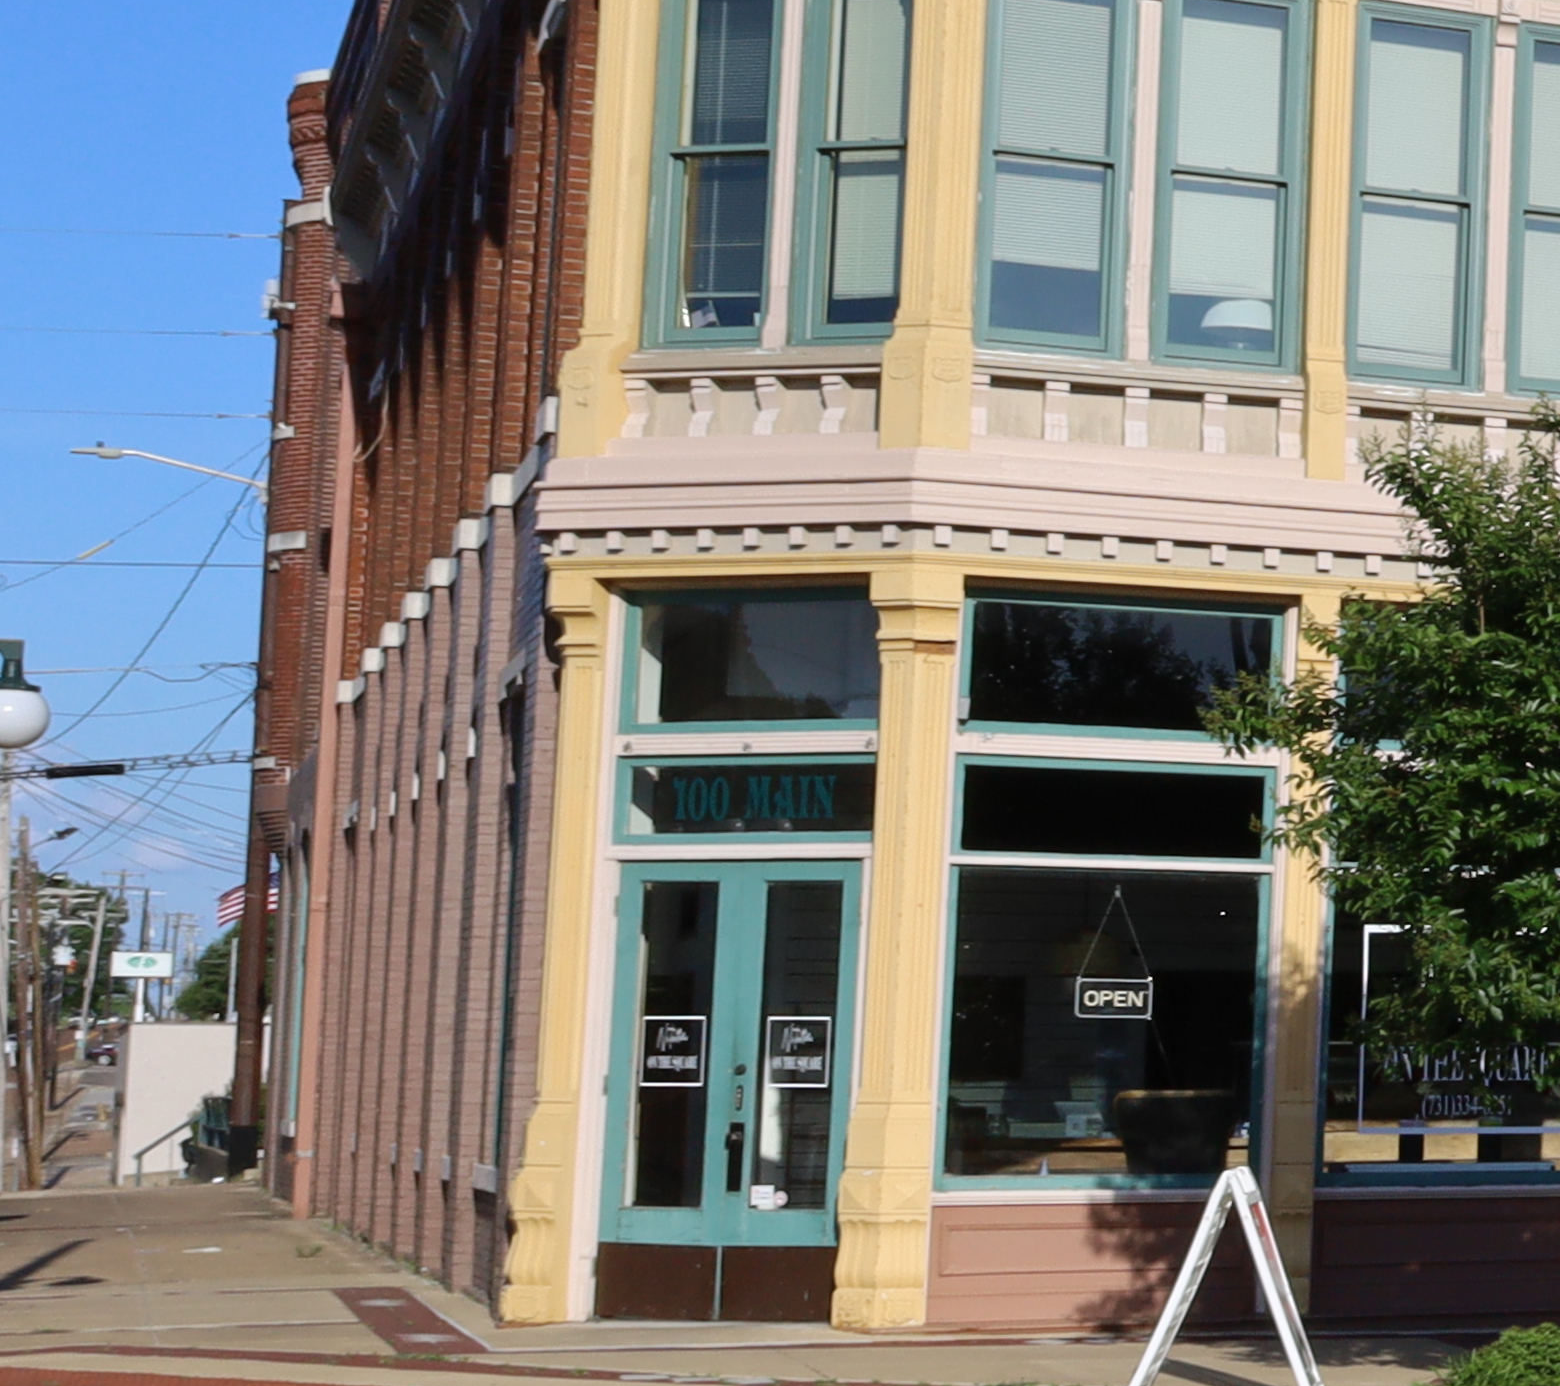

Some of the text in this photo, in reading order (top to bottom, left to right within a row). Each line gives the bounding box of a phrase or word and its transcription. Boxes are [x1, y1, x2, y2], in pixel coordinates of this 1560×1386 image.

[673, 775, 837, 822] 100 MAIN
[1083, 990, 1144, 1007] OPEN
